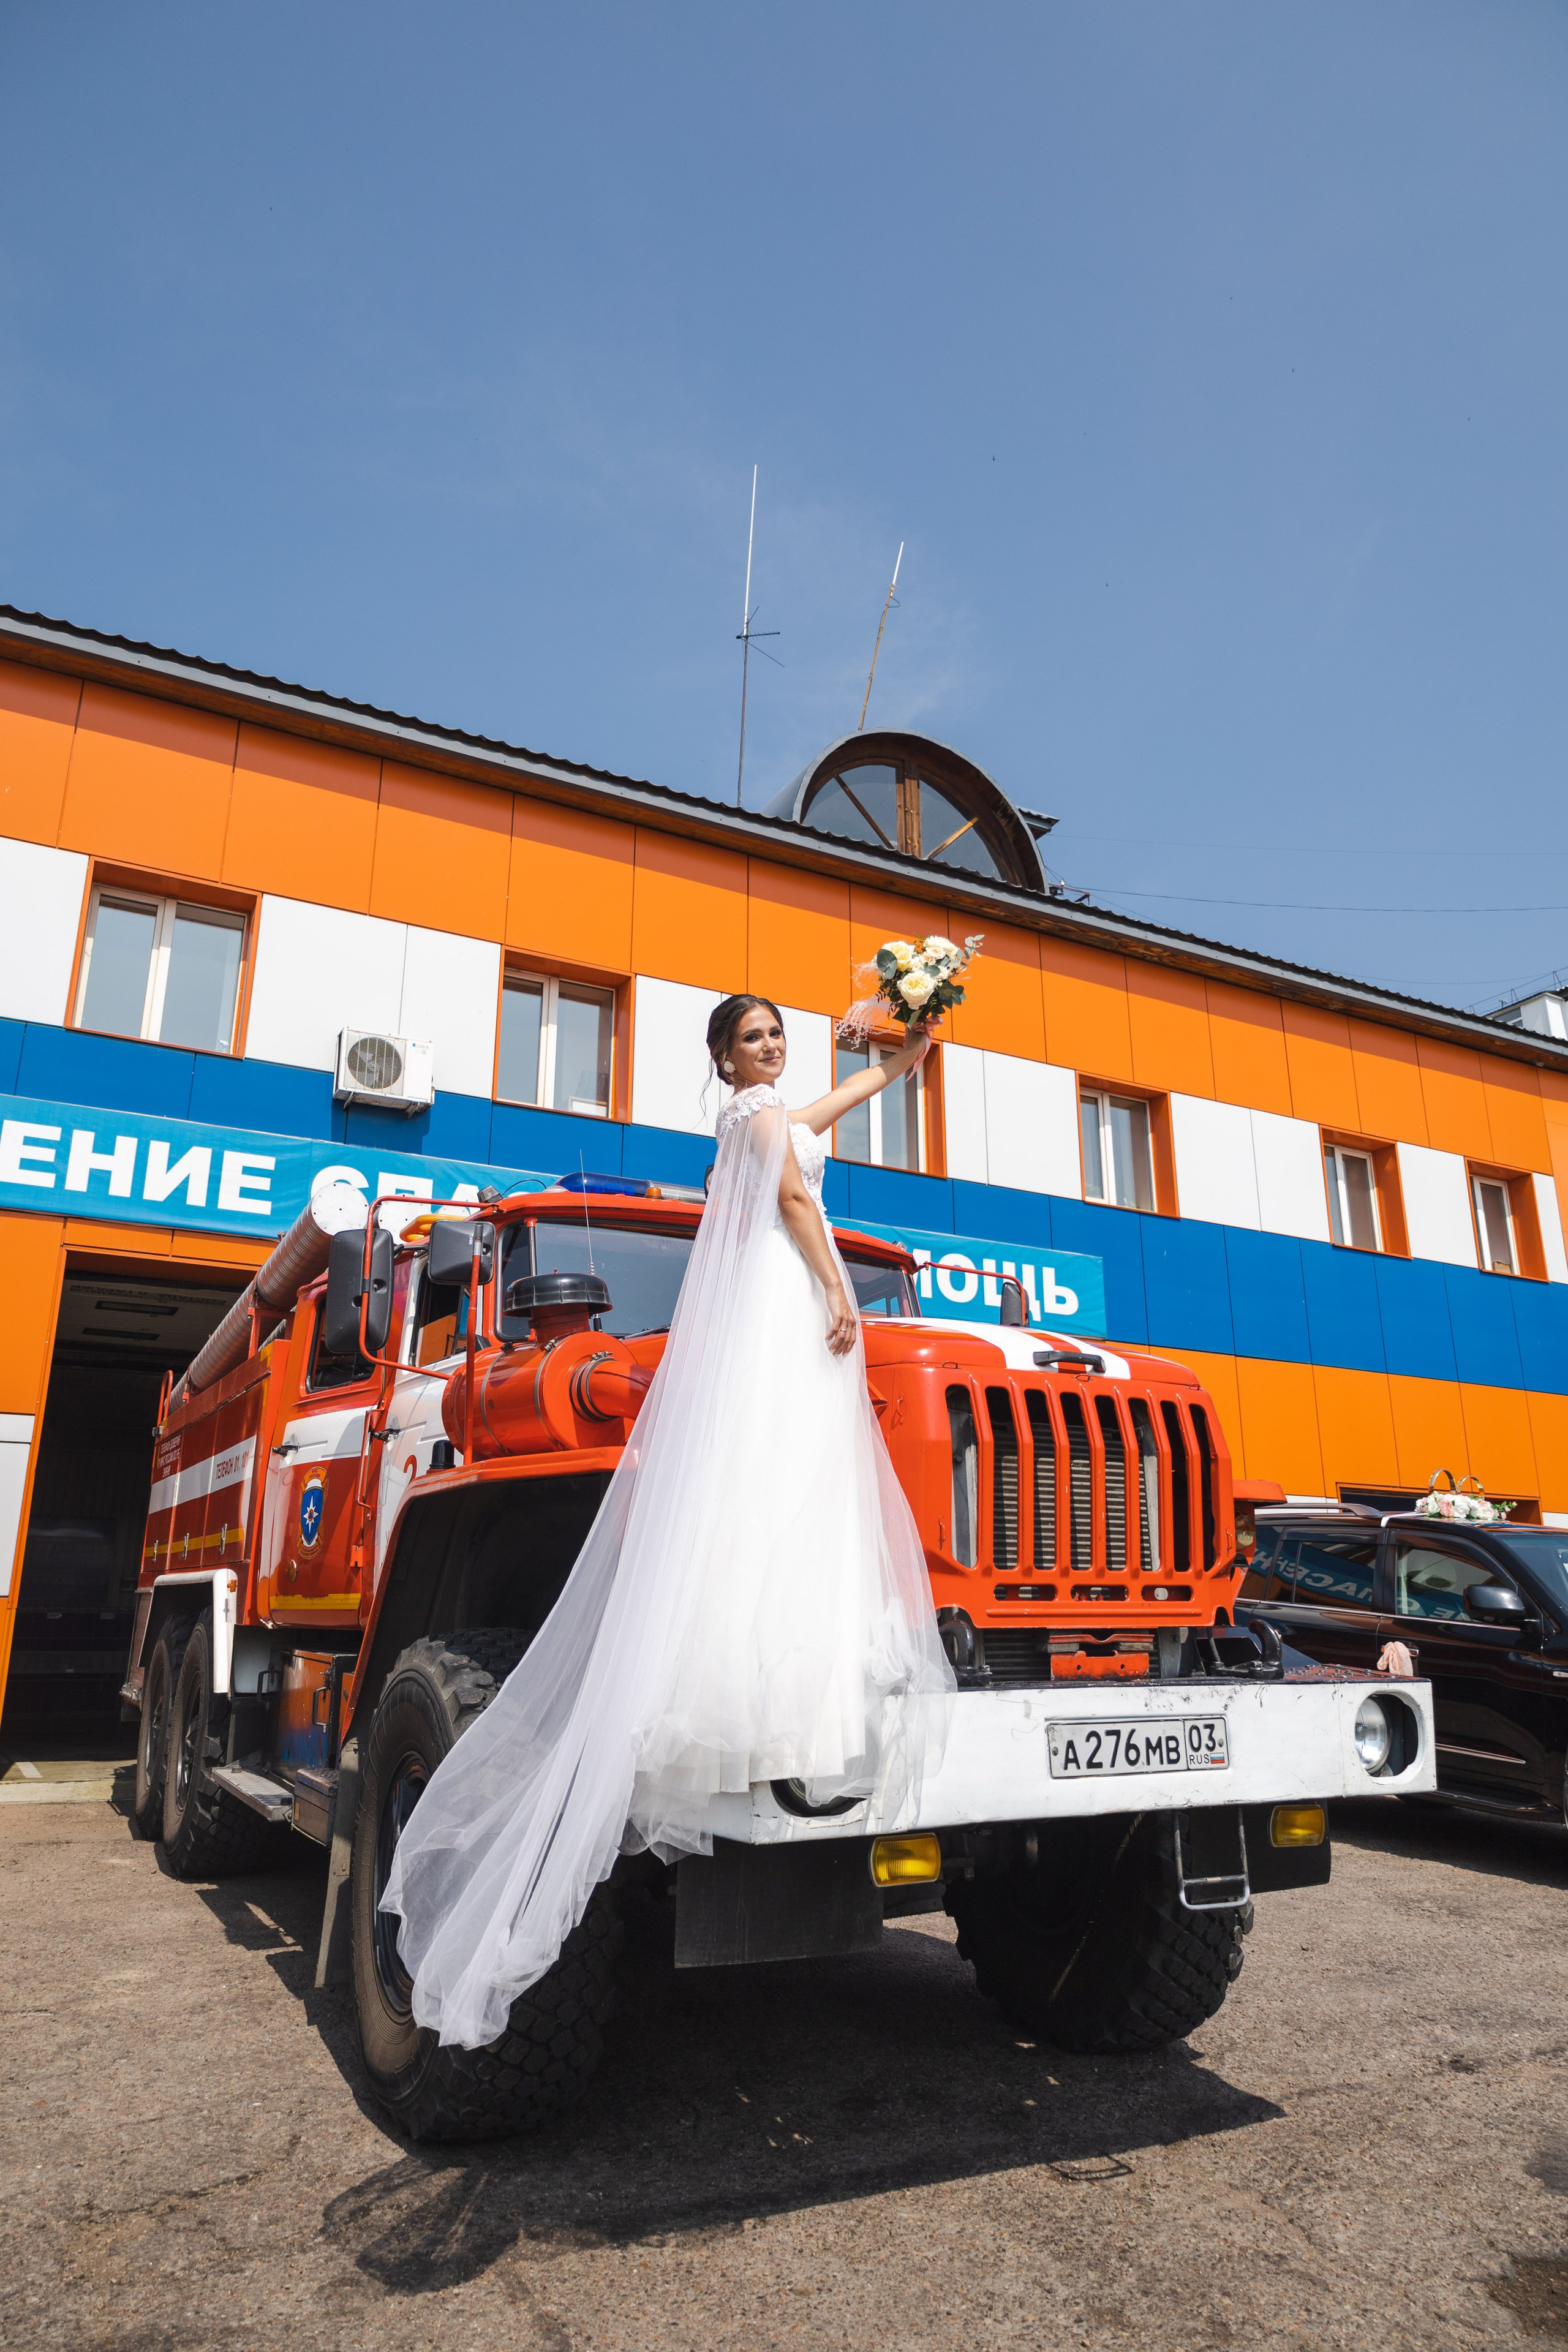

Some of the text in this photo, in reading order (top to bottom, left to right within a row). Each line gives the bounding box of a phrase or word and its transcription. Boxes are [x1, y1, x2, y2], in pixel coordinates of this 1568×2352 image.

[216, 1457, 234, 1480] ТЕЛЕФОН
[1188, 1723, 1217, 1753] 03
[1189, 1753, 1210, 1765] RUS
